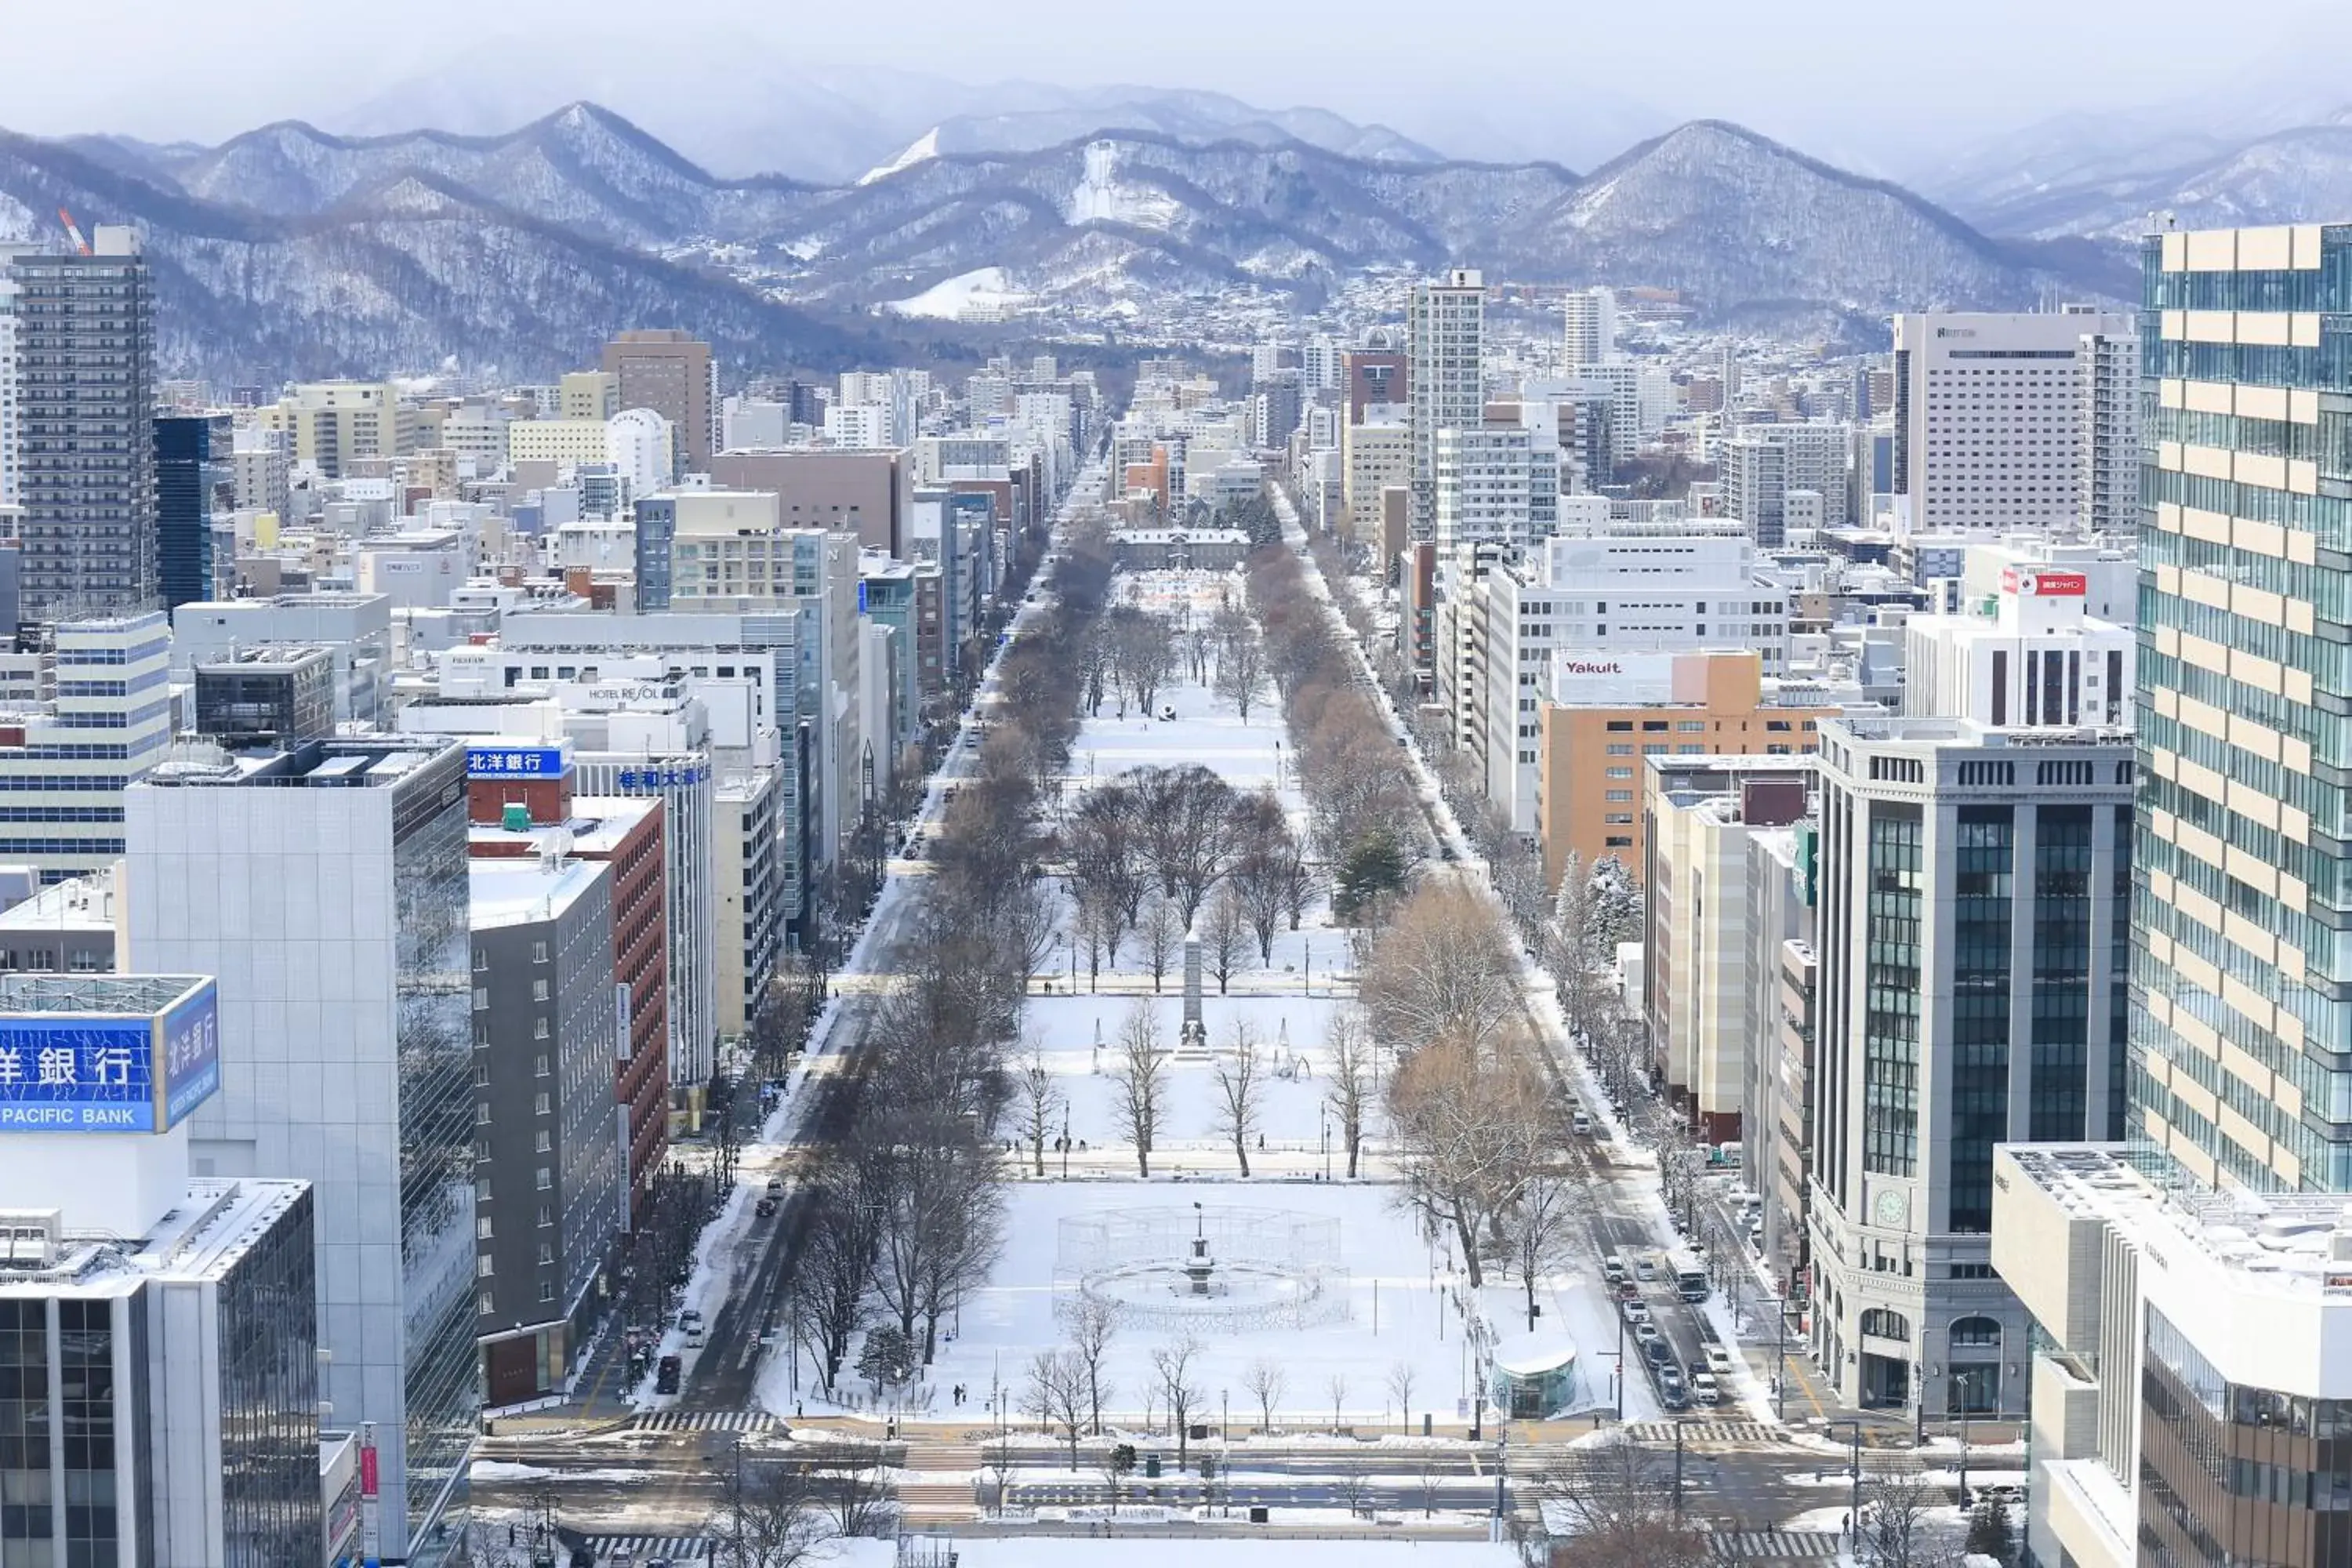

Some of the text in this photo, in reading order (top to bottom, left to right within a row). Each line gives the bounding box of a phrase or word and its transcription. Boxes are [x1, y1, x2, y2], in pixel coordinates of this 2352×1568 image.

[1566, 662, 1622, 673] Yakult
[589, 689, 619, 699] HOTEL
[470, 753, 542, 771] 北洋銀行
[169, 1011, 214, 1078] 北洋銀行
[2, 1108, 134, 1123] PACIFIC BANK
